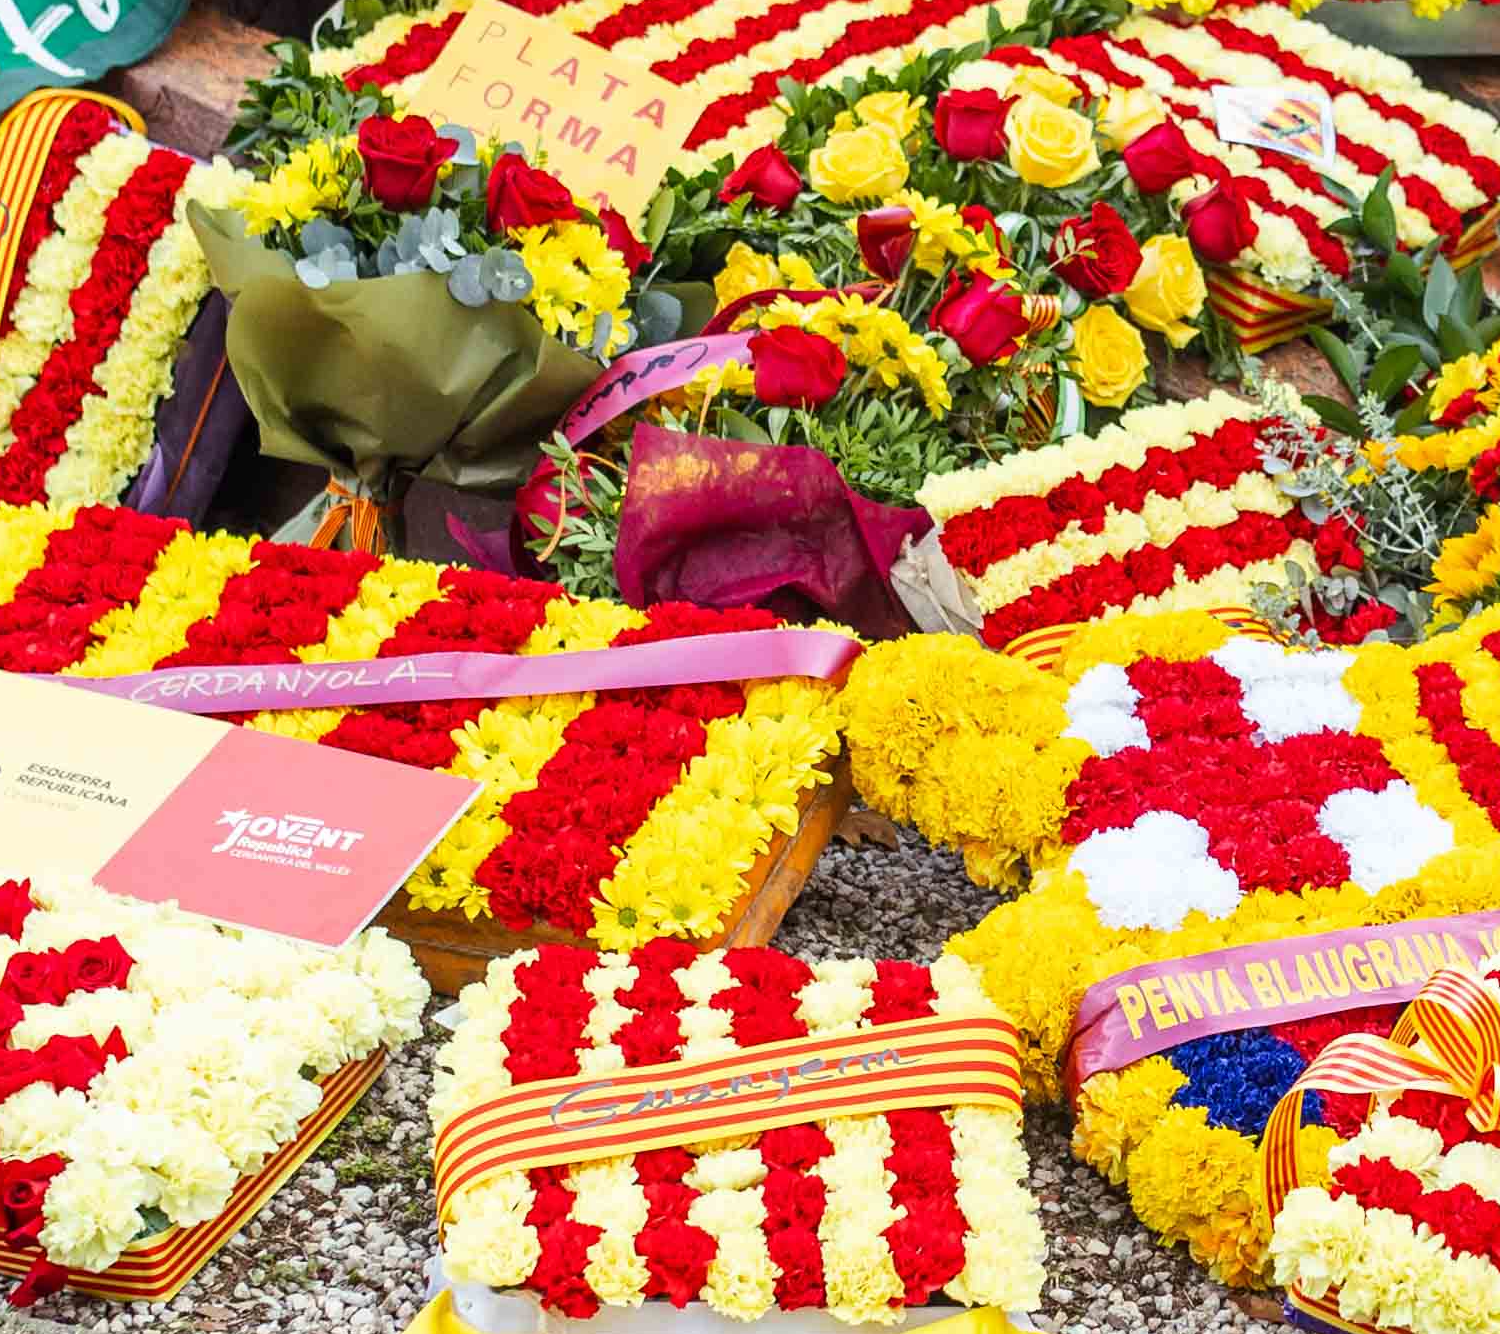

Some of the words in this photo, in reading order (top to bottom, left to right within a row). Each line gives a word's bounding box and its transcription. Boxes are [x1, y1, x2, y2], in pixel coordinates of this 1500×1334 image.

[477, 19, 667, 130] PLATA
[447, 62, 639, 178] FORMA
[130, 659, 453, 704] CERDANYOLA
[16, 773, 130, 808] REPUBLICANA
[27, 762, 112, 790] ESQUERRA
[1115, 967, 1252, 1041] PENYA
[1243, 930, 1475, 1009] BLAUGRANA
[549, 1048, 924, 1132] Guanyem
